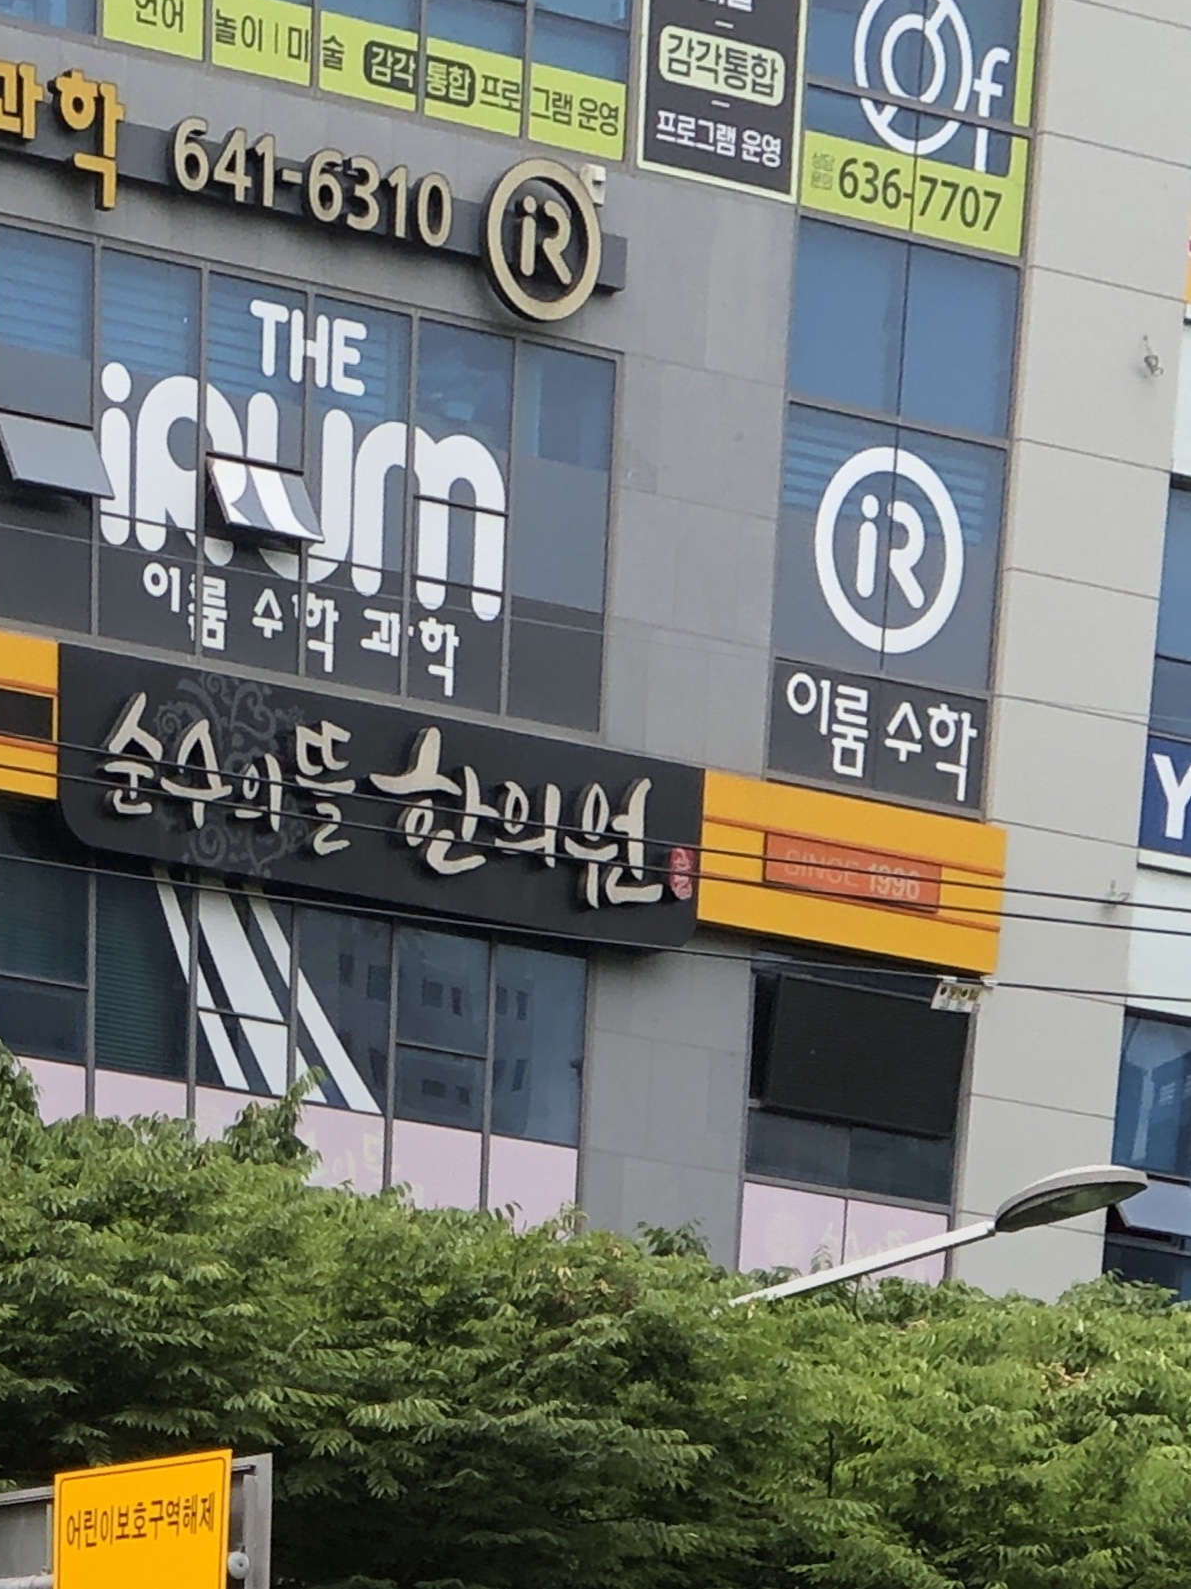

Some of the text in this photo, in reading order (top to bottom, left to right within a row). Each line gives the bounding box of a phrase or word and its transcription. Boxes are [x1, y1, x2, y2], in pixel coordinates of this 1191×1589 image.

[213, 7, 264, 54] 놀이
[287, 26, 346, 72] 미술
[368, 46, 474, 104] 감각통합
[479, 75, 574, 127] 프로그램
[577, 96, 621, 138] 운영
[665, 32, 777, 98] 감각통합
[171, 115, 454, 249] 641-6310
[655, 109, 783, 169] 프로그램 운영
[839, 156, 1004, 234] 636-7707
[249, 298, 368, 398] THE
[142, 561, 460, 698] 이룸 수학 과학
[785, 671, 979, 803] 이룸 수학
[370, 725, 663, 910] 한의원
